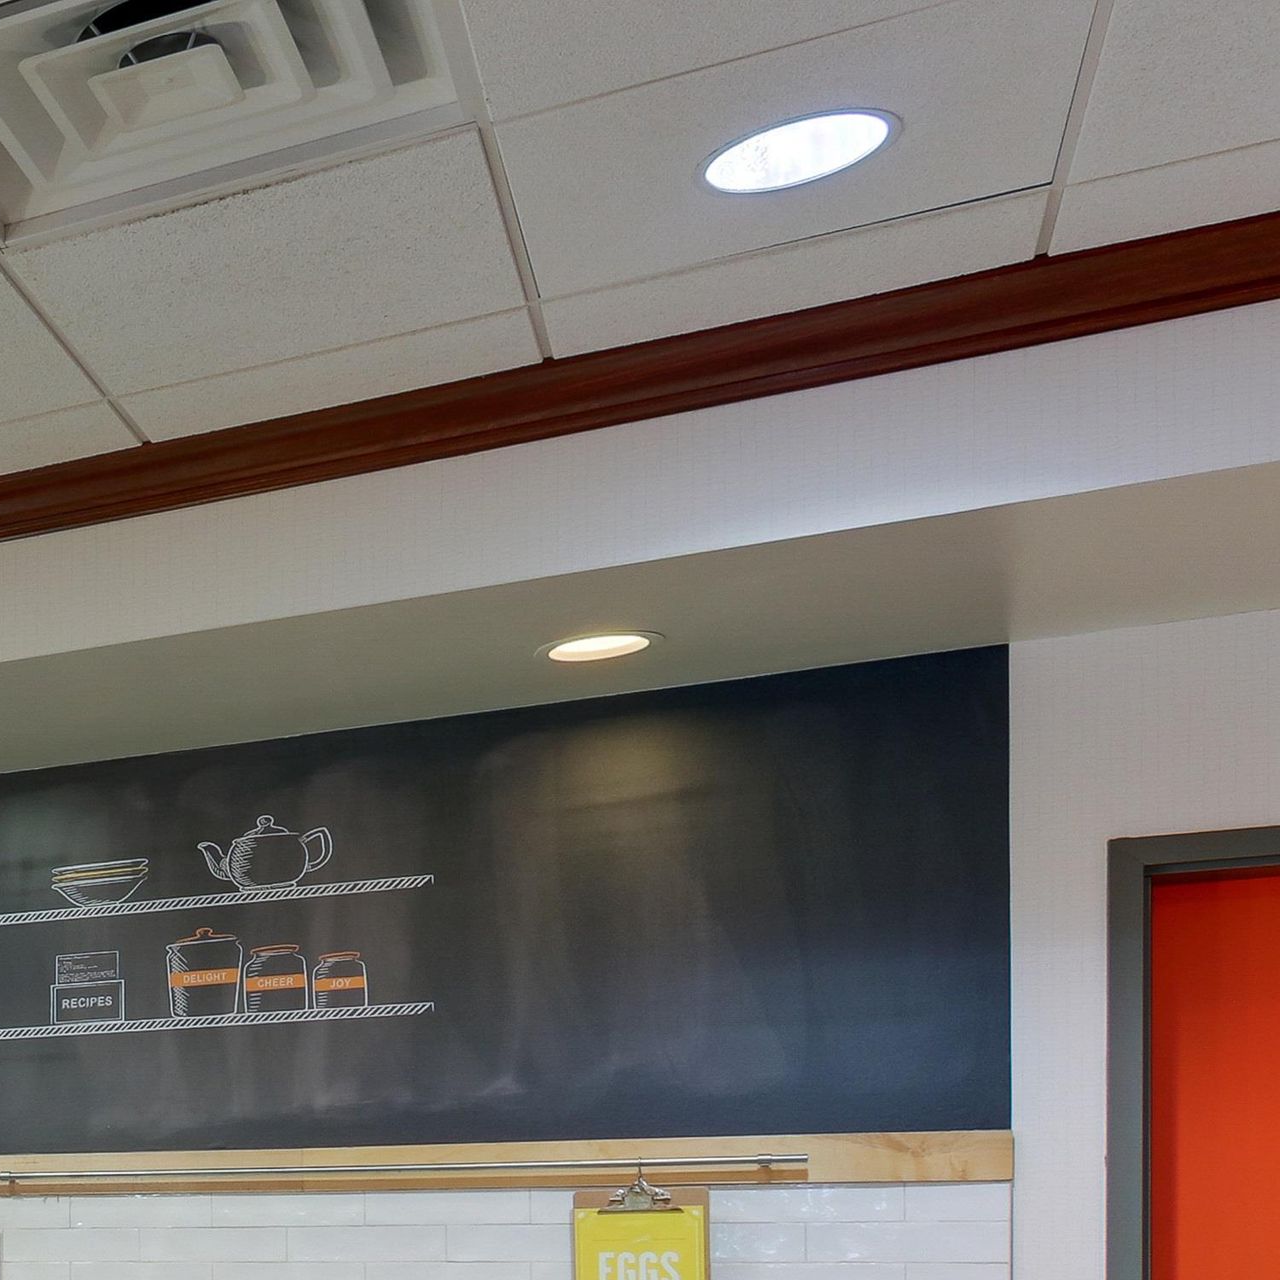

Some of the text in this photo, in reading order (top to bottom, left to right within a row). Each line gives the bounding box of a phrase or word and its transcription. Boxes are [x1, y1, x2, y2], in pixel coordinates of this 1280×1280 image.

[183, 972, 227, 984] DELIGHT
[257, 977, 294, 988] CHEER
[330, 978, 352, 988] JOY
[62, 995, 113, 1009] RECIPES
